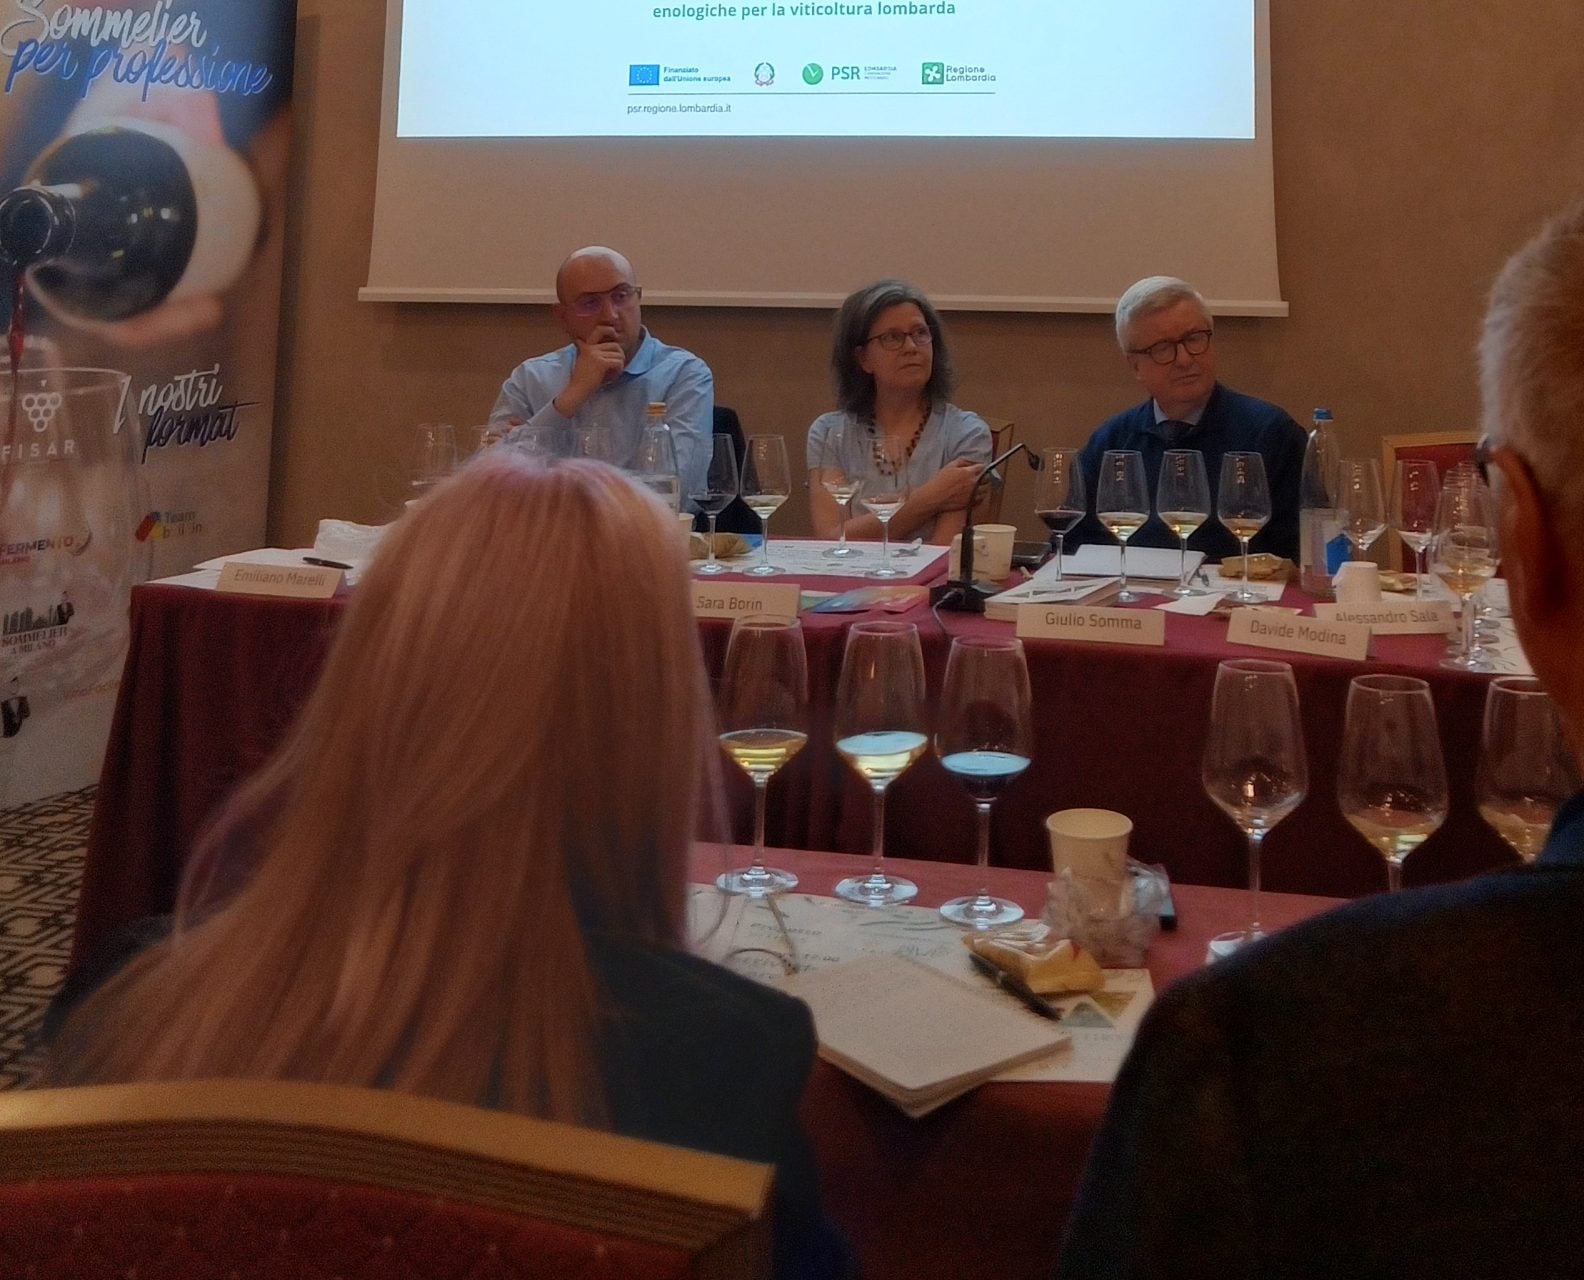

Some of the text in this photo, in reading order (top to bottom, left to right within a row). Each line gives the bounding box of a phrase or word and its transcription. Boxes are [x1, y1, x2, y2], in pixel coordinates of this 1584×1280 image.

[653, 1, 956, 21] enologiche per la viticoltura lombarda
[4, 38, 273, 103] per professione
[831, 66, 861, 81] PSR
[946, 65, 986, 75] Regione
[946, 74, 997, 83] Lombardia
[627, 104, 732, 115] psr.regione.lombardia.it
[138, 363, 223, 417] nostri
[0, 439, 76, 464] FISAR
[234, 568, 326, 587] Emiliano Marelli
[695, 595, 763, 611] Sara Borin
[1045, 611, 1143, 631] Giulio Somma
[1335, 608, 1440, 625] Alessandro Sala
[1250, 619, 1348, 646] Davide Modina
